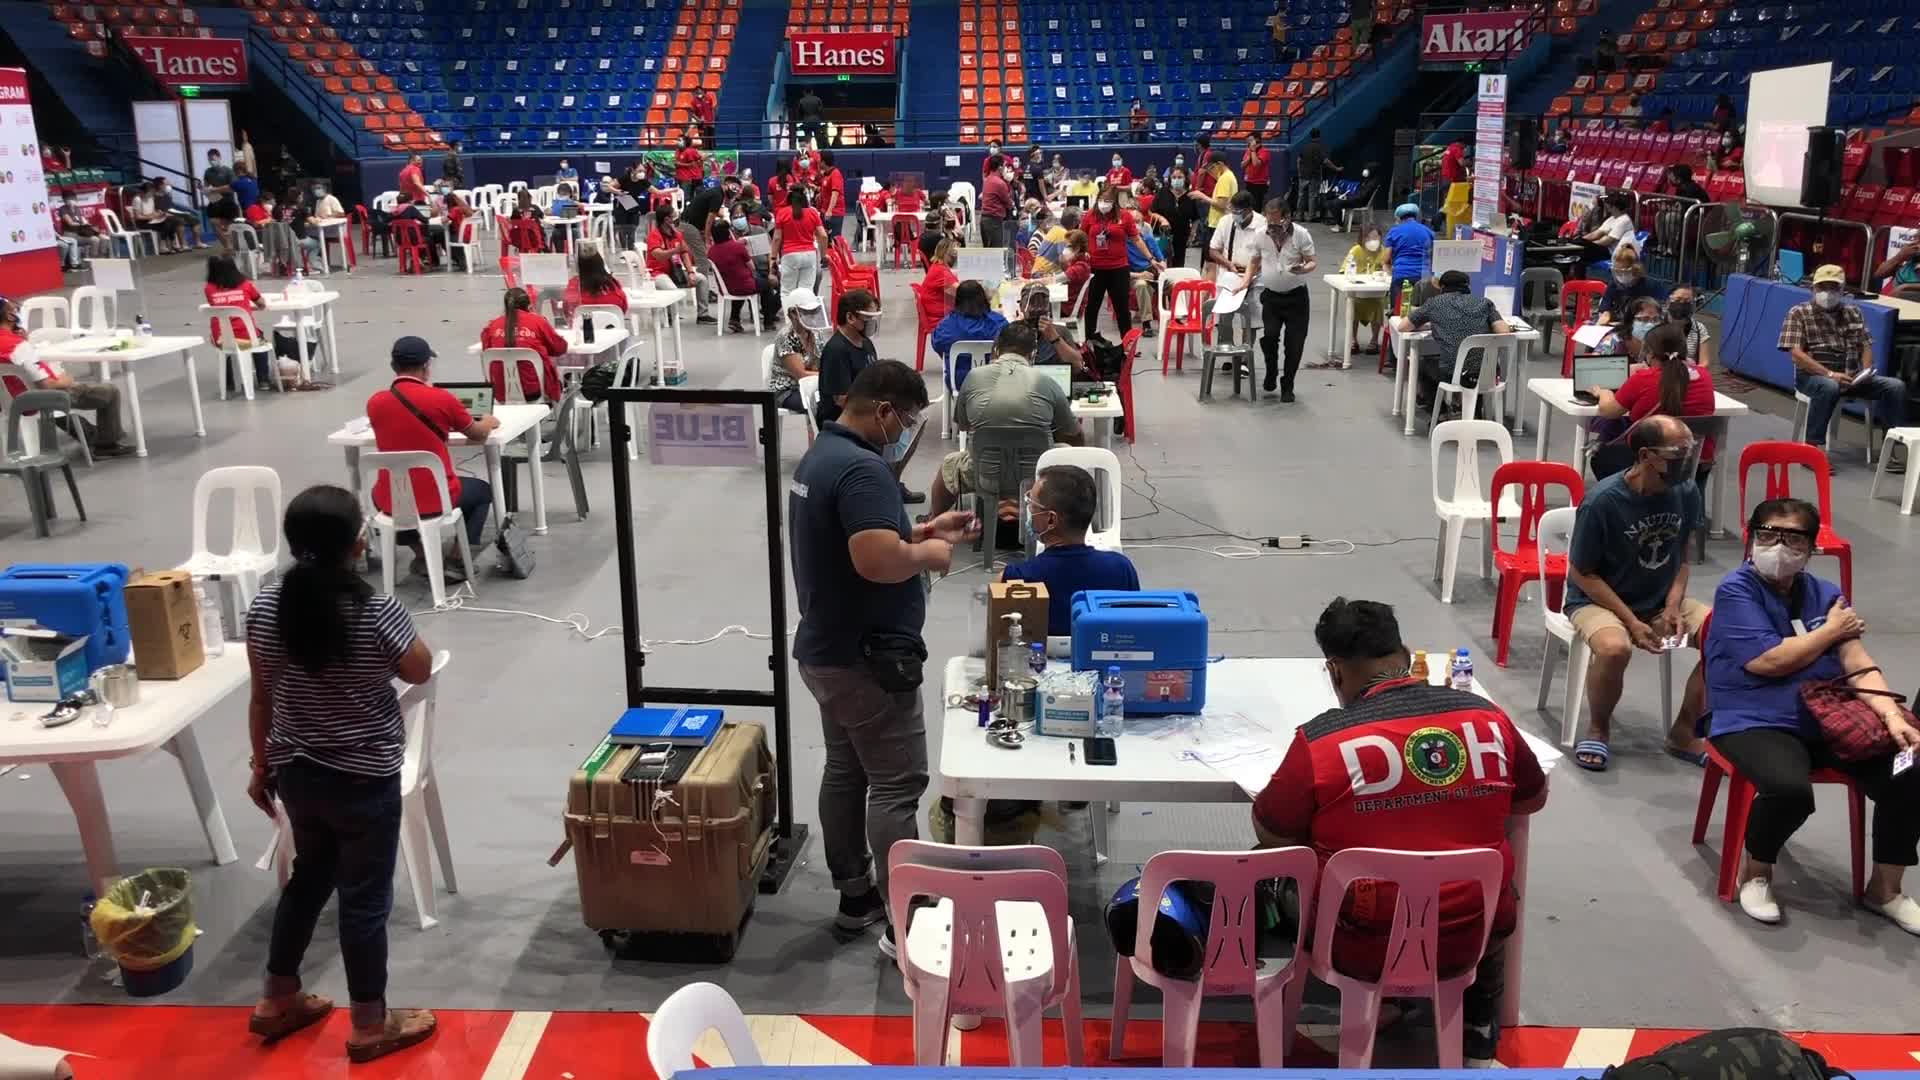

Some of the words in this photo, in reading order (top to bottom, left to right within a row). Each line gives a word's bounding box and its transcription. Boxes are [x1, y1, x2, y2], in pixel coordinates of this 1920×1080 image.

[1423, 19, 1525, 53] Akari
[133, 46, 238, 76] Hanes
[795, 40, 886, 67] Hanes
[1354, 790, 1449, 813] DEPARTMENT
[1455, 786, 1469, 800] OF
